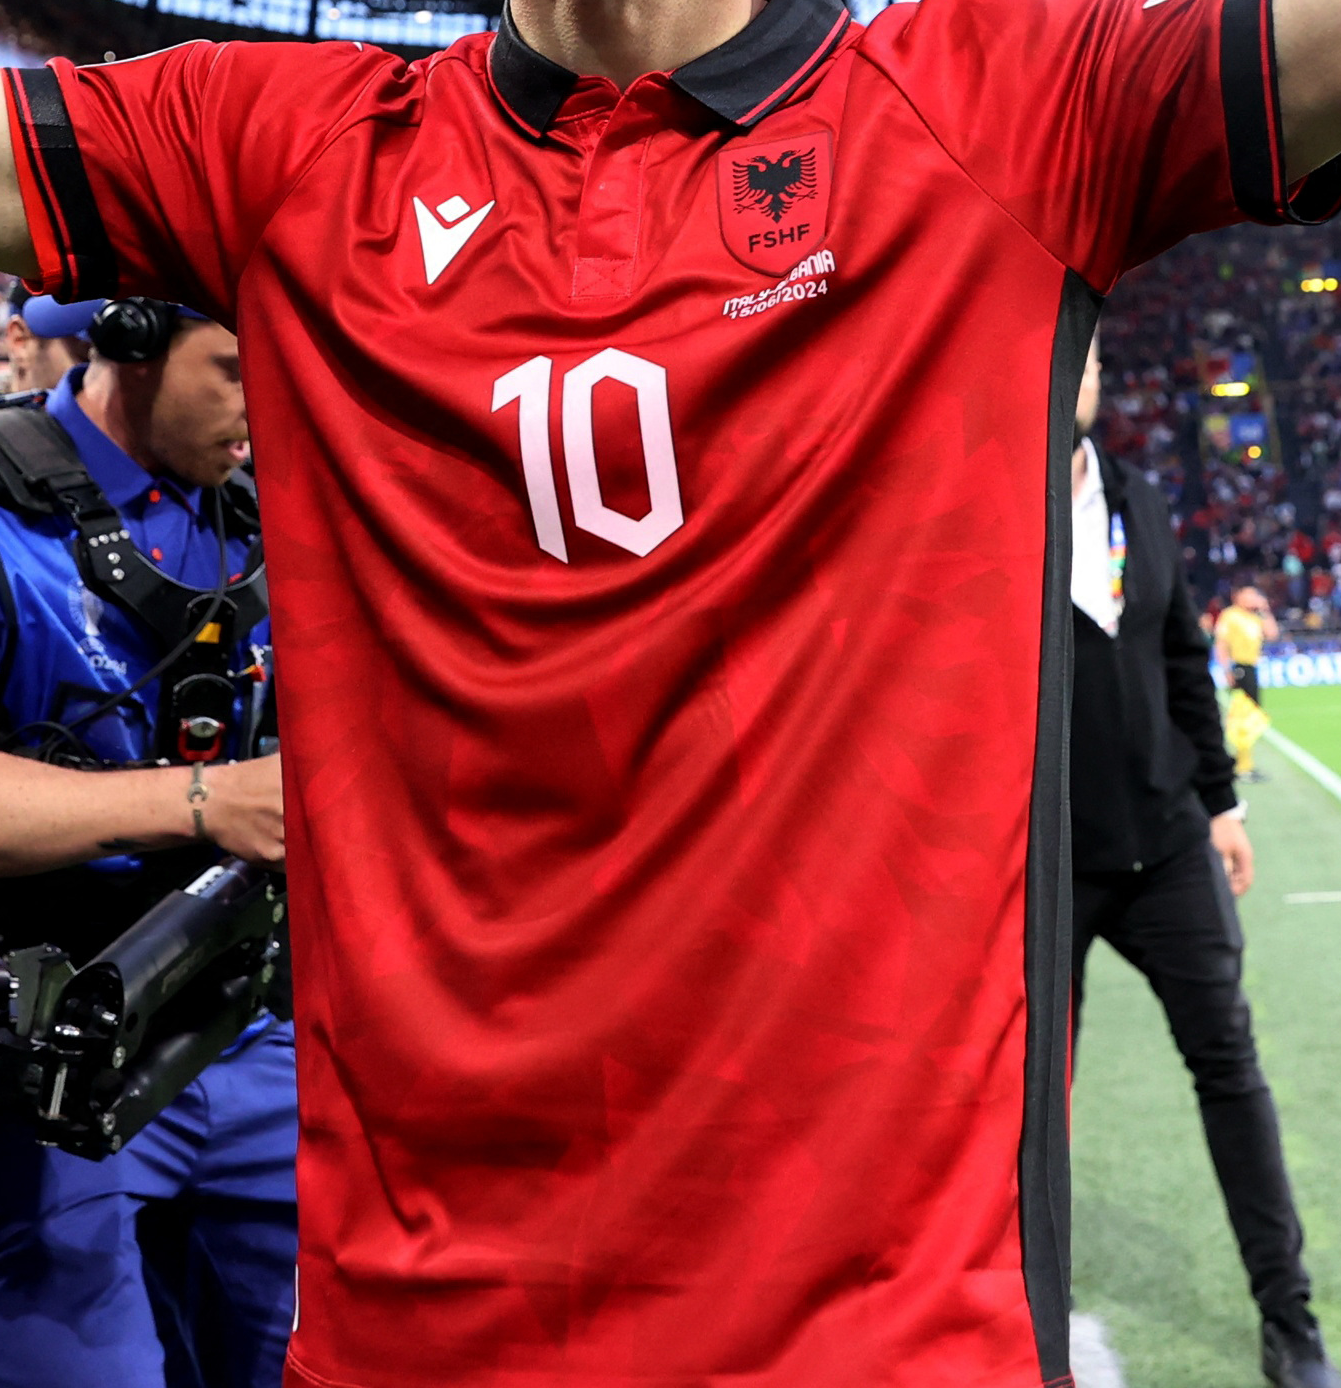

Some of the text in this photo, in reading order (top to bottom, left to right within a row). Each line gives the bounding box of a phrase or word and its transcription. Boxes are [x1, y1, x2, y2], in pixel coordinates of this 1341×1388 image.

[748, 223, 811, 253] FSHF
[729, 279, 828, 319] 15/06/2024
[491, 347, 685, 564] 10
